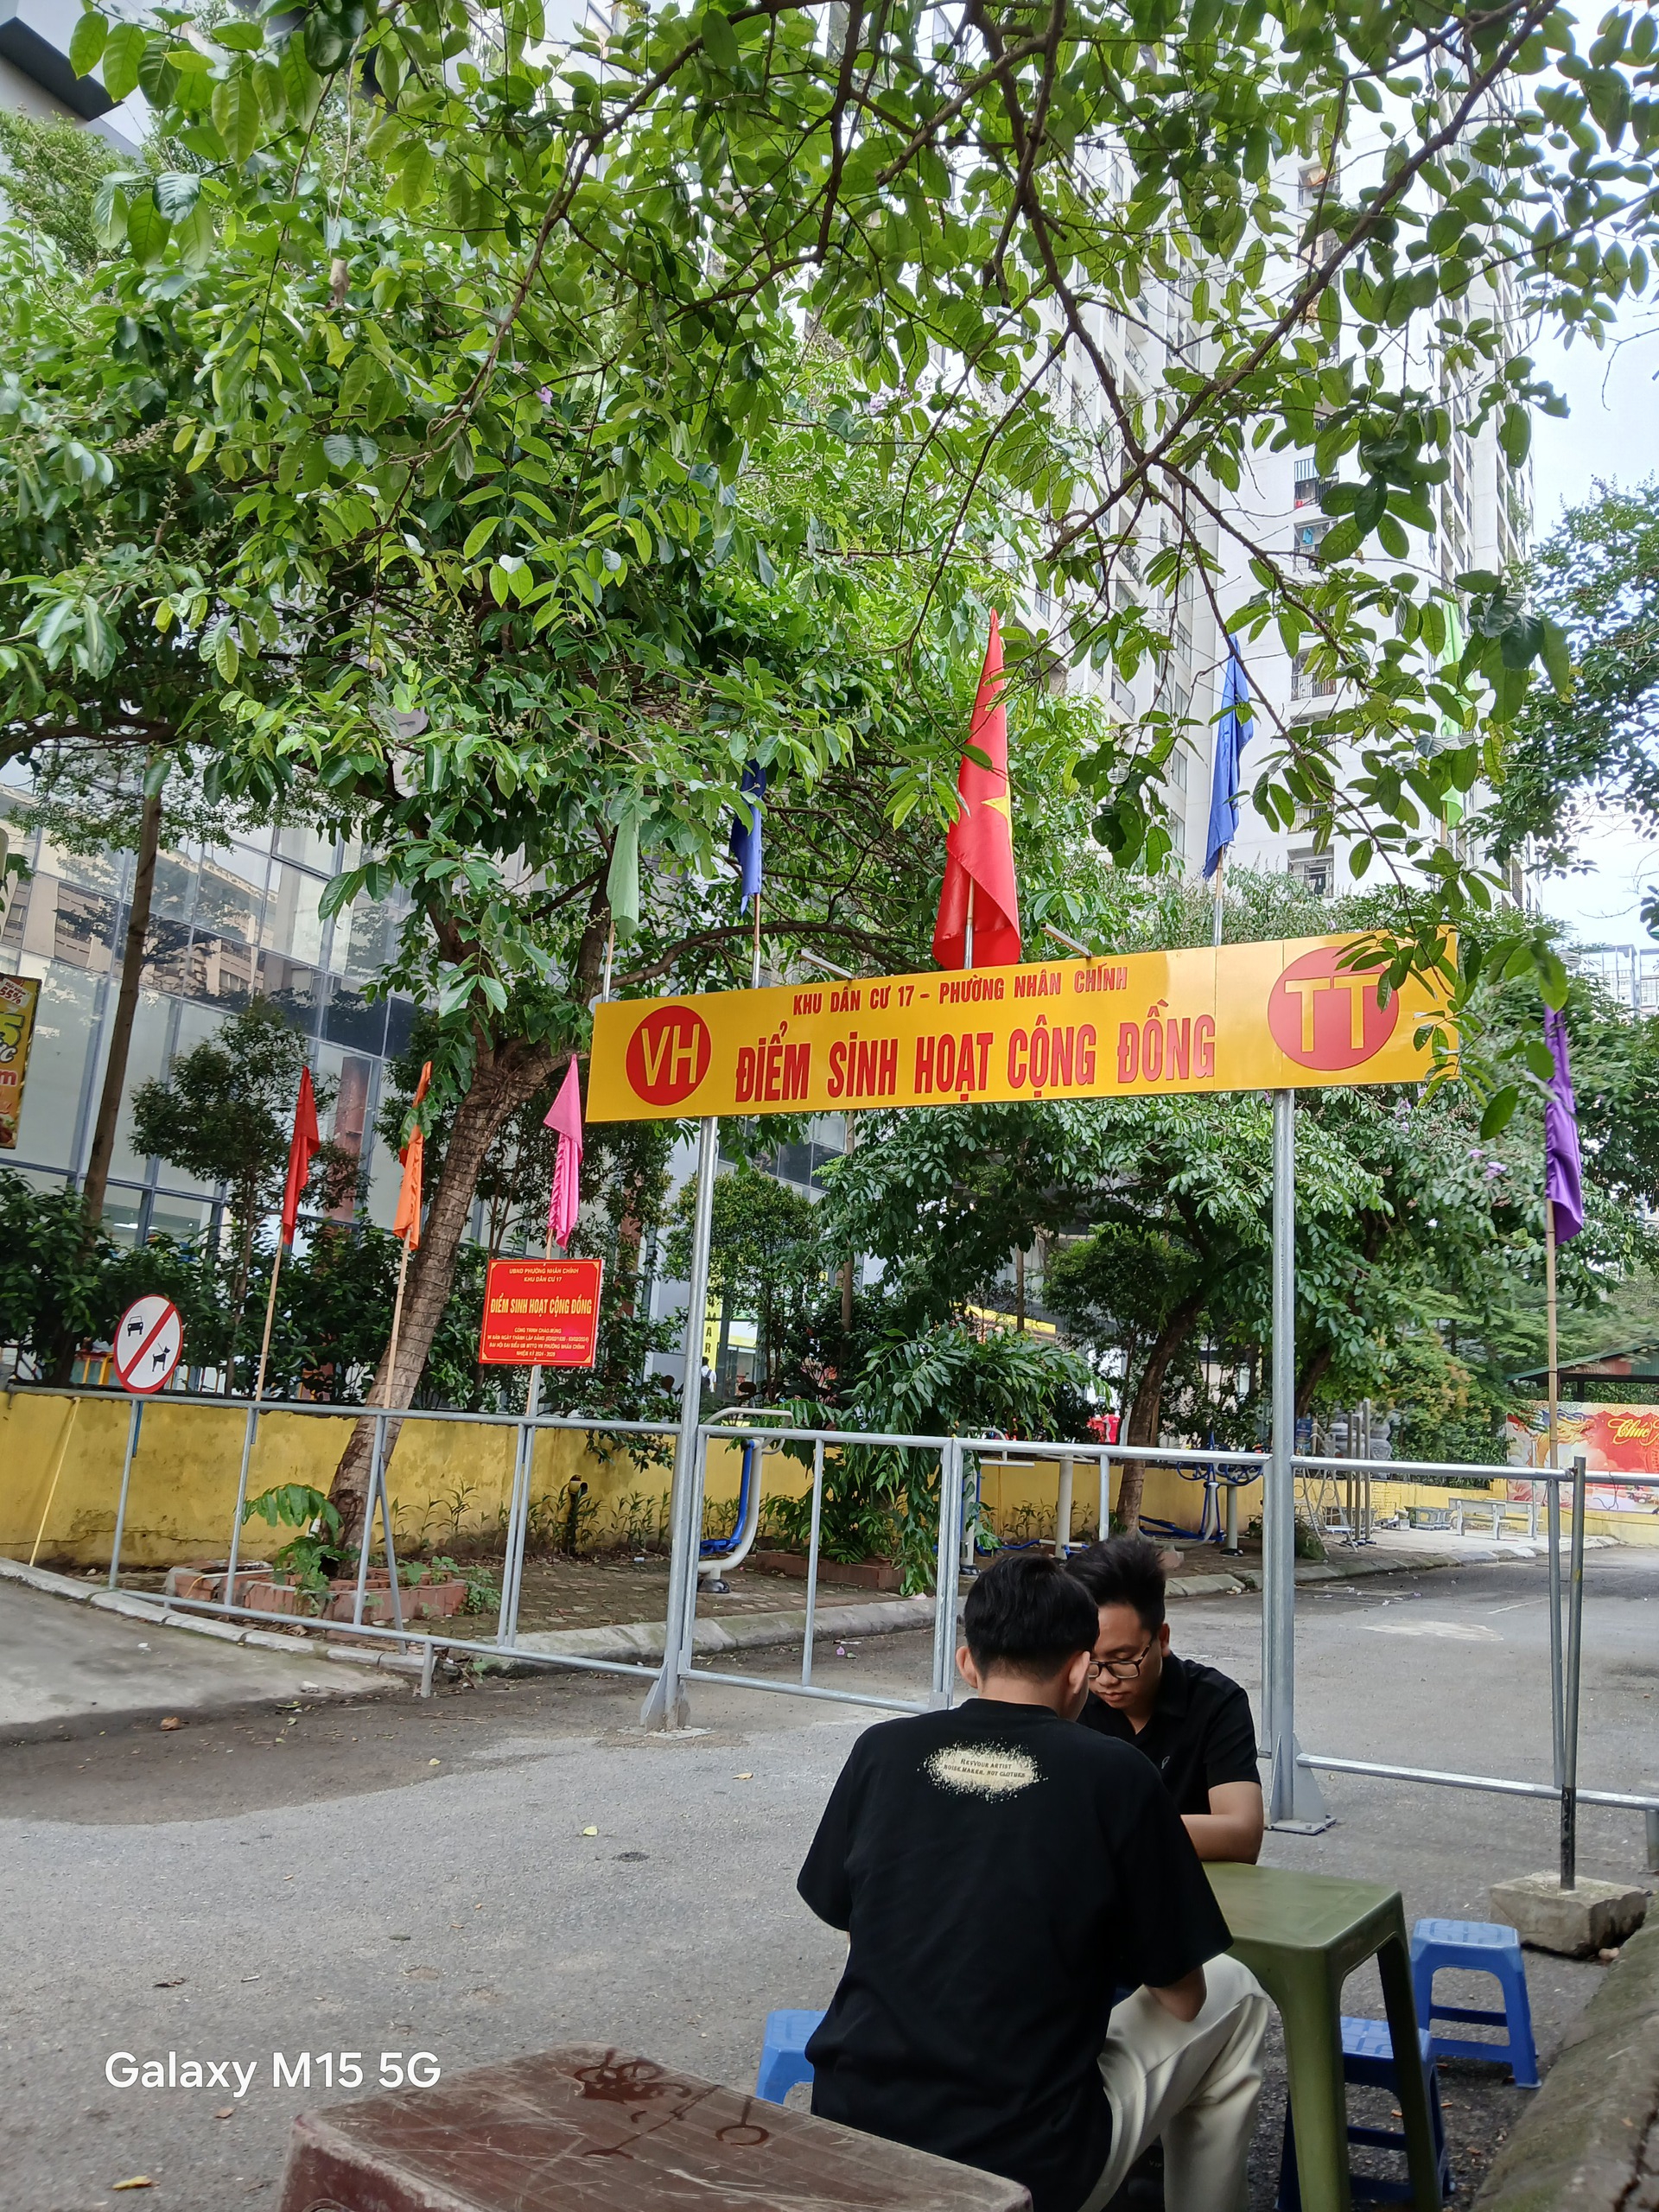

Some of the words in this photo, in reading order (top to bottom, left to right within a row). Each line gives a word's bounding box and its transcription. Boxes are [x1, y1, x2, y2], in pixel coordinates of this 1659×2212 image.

[792, 991, 822, 1016] KHU
[830, 985, 861, 1013] DÂN
[869, 984, 893, 1010] CƯ
[897, 985, 915, 1007] 17
[939, 976, 1005, 1004] PHƯỜNG
[1014, 969, 1061, 999] NHÂN
[1074, 962, 1128, 993] CHÍNH
[1284, 970, 1382, 1053] TT
[640, 1021, 701, 1087] VH
[915, 1031, 995, 1103] HOẠT
[1007, 1014, 1097, 1098] CỘNG
[1116, 999, 1216, 1084] ĐỒNG
[490, 1293, 509, 1314] ĐIỂM
[510, 1298, 528, 1314] SINH
[529, 1298, 549, 1318] HOẠT
[550, 1295, 570, 1318] CỘNG
[570, 1294, 593, 1315] ĐỒNG
[1608, 1418, 1652, 1445] Chúc
